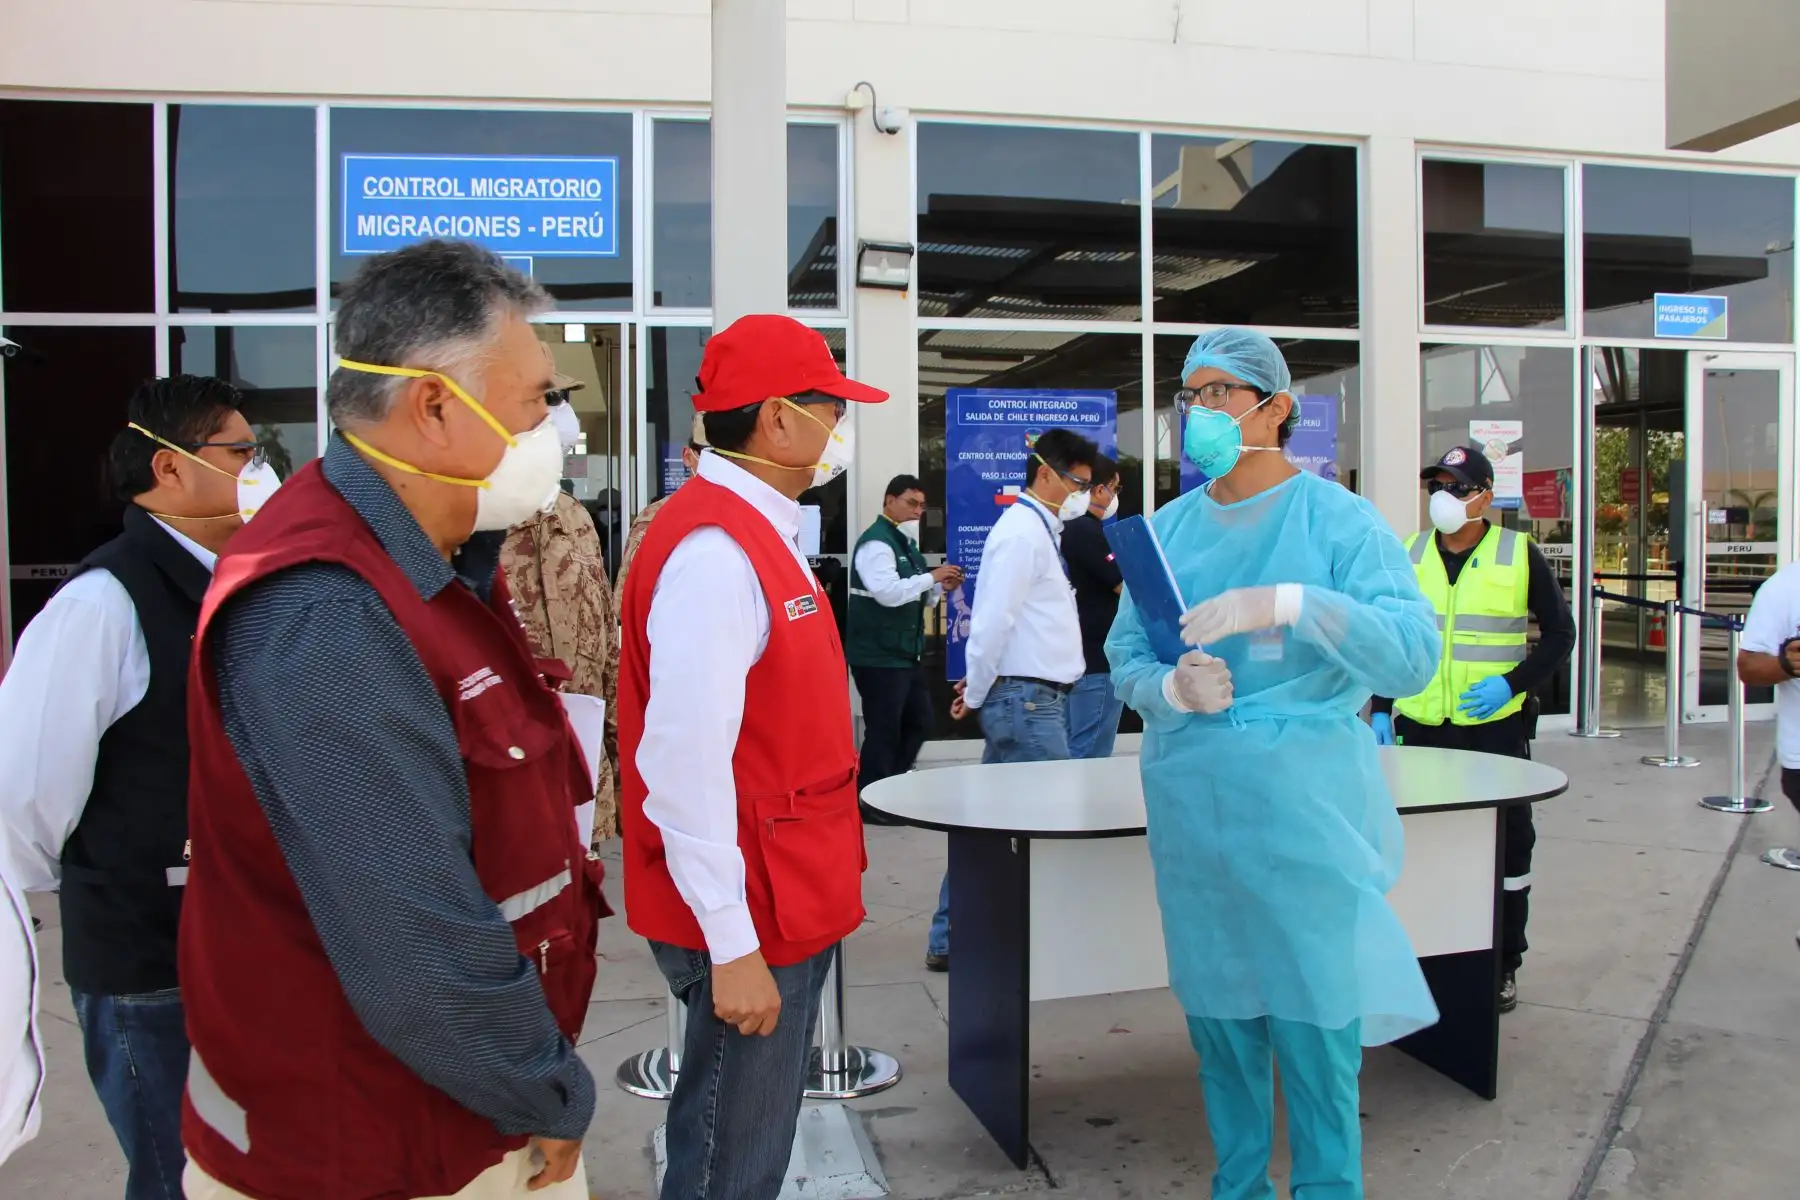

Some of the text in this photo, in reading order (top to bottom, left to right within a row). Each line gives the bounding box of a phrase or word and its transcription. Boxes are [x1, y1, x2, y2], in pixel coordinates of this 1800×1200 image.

[363, 176, 602, 198] CONTROL MIGRATORIO
[357, 214, 521, 237] MIGRACIONES
[542, 211, 603, 237] PERÚ
[1659, 305, 1709, 314] INGRESO DE
[1659, 313, 1708, 324] PASAJEROS
[988, 399, 1078, 410] CONTROL INTEGRADO
[965, 412, 1100, 423] SALIDA DE CHILE E INGRESO AL PERÚ
[958, 451, 1028, 461] CENTRO DE ATENCIÓN
[981, 471, 1000, 480] PASO
